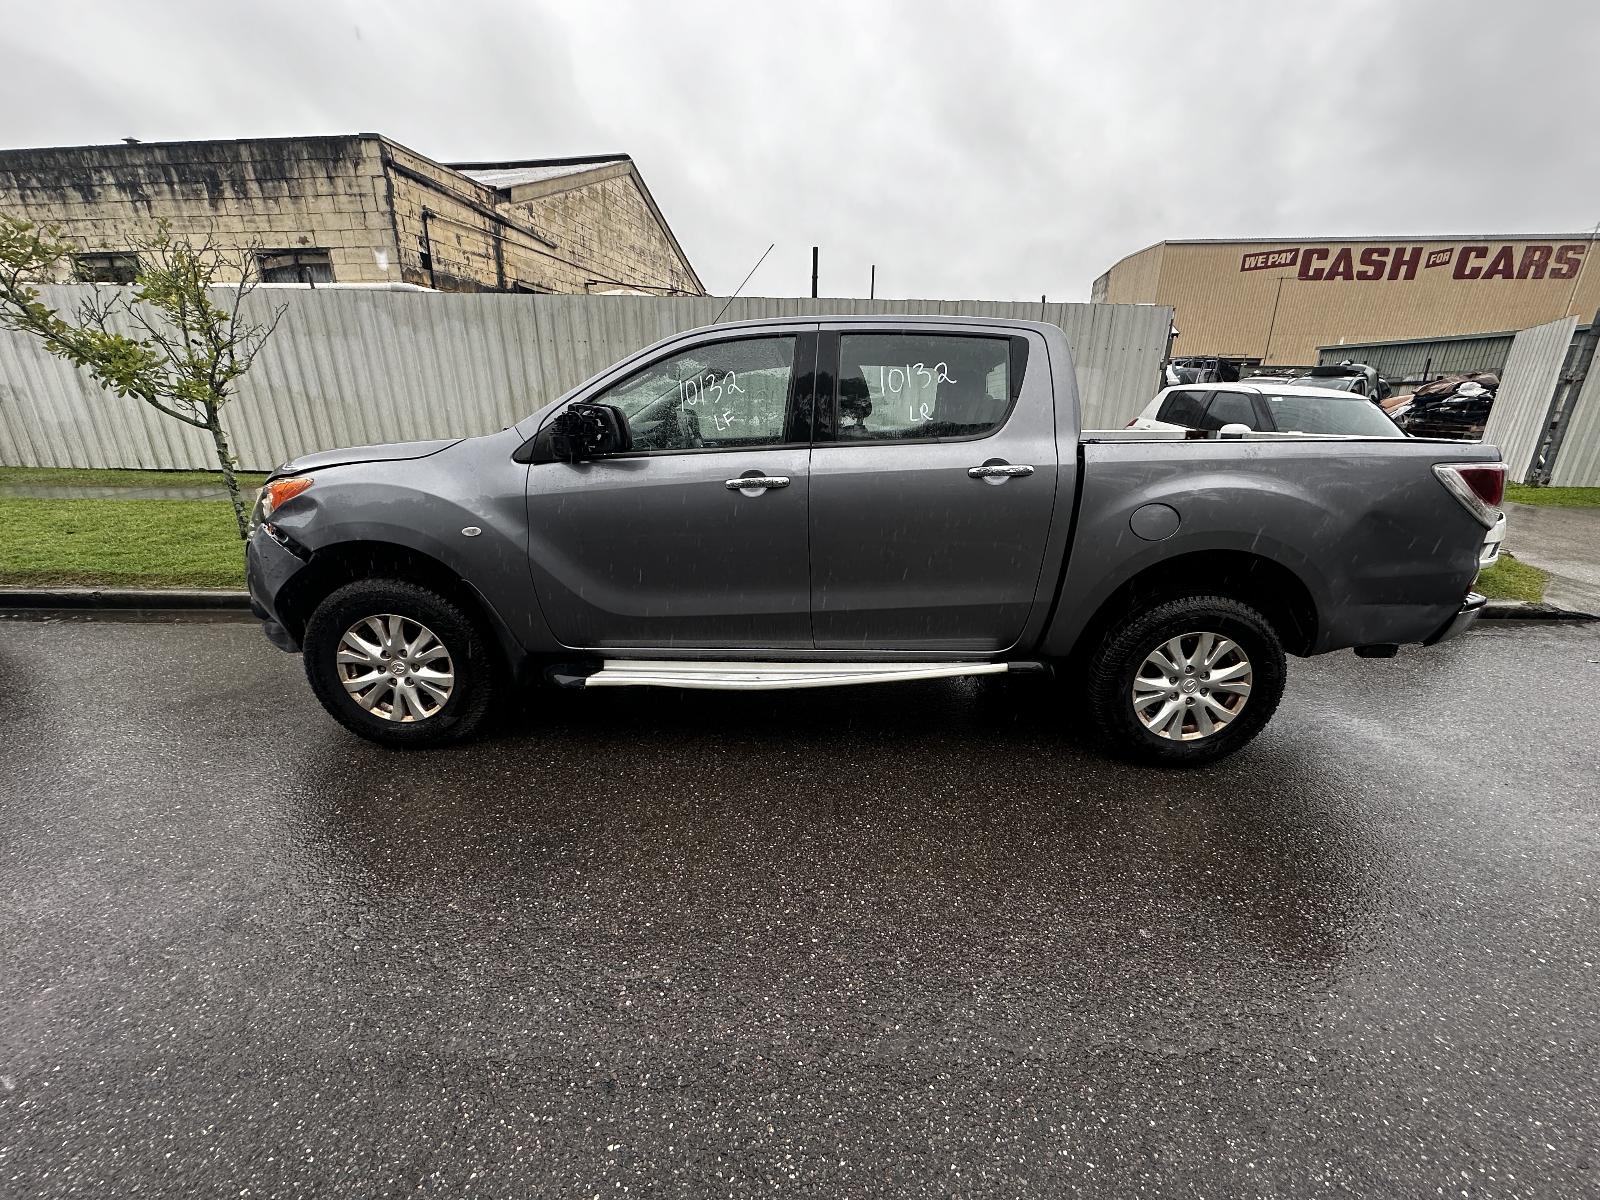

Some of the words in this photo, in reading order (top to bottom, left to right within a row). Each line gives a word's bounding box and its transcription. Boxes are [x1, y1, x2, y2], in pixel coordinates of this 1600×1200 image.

[1244, 253, 1267, 269] WE
[1268, 251, 1294, 267] PAY
[1298, 247, 1424, 281] CASH
[1428, 252, 1451, 266] FOR
[1452, 244, 1586, 280] CARS
[679, 370, 746, 412] 10132
[880, 362, 957, 397] 10132
[713, 410, 735, 431] LF
